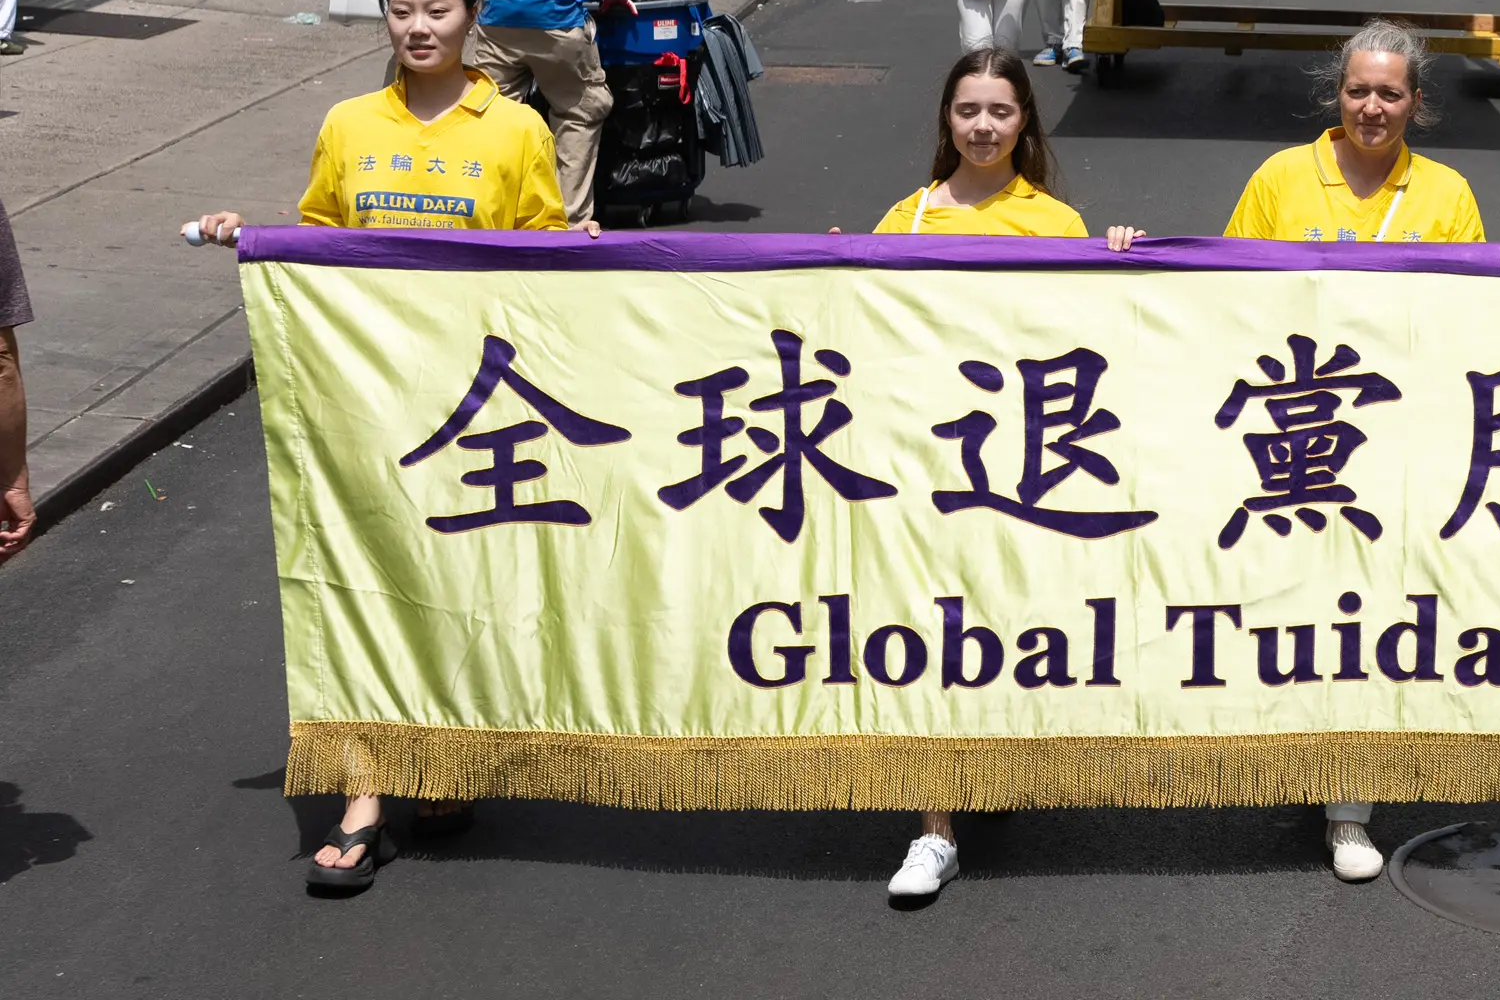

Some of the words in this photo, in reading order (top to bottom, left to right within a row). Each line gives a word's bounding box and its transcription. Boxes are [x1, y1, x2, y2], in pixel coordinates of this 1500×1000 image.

[657, 19, 675, 27] ULINE
[357, 153, 484, 178] 法輪大法
[358, 192, 417, 210] FALUN
[422, 197, 468, 214] DAFA
[358, 214, 455, 229] www.falundafa.org
[727, 592, 1120, 692] Global
